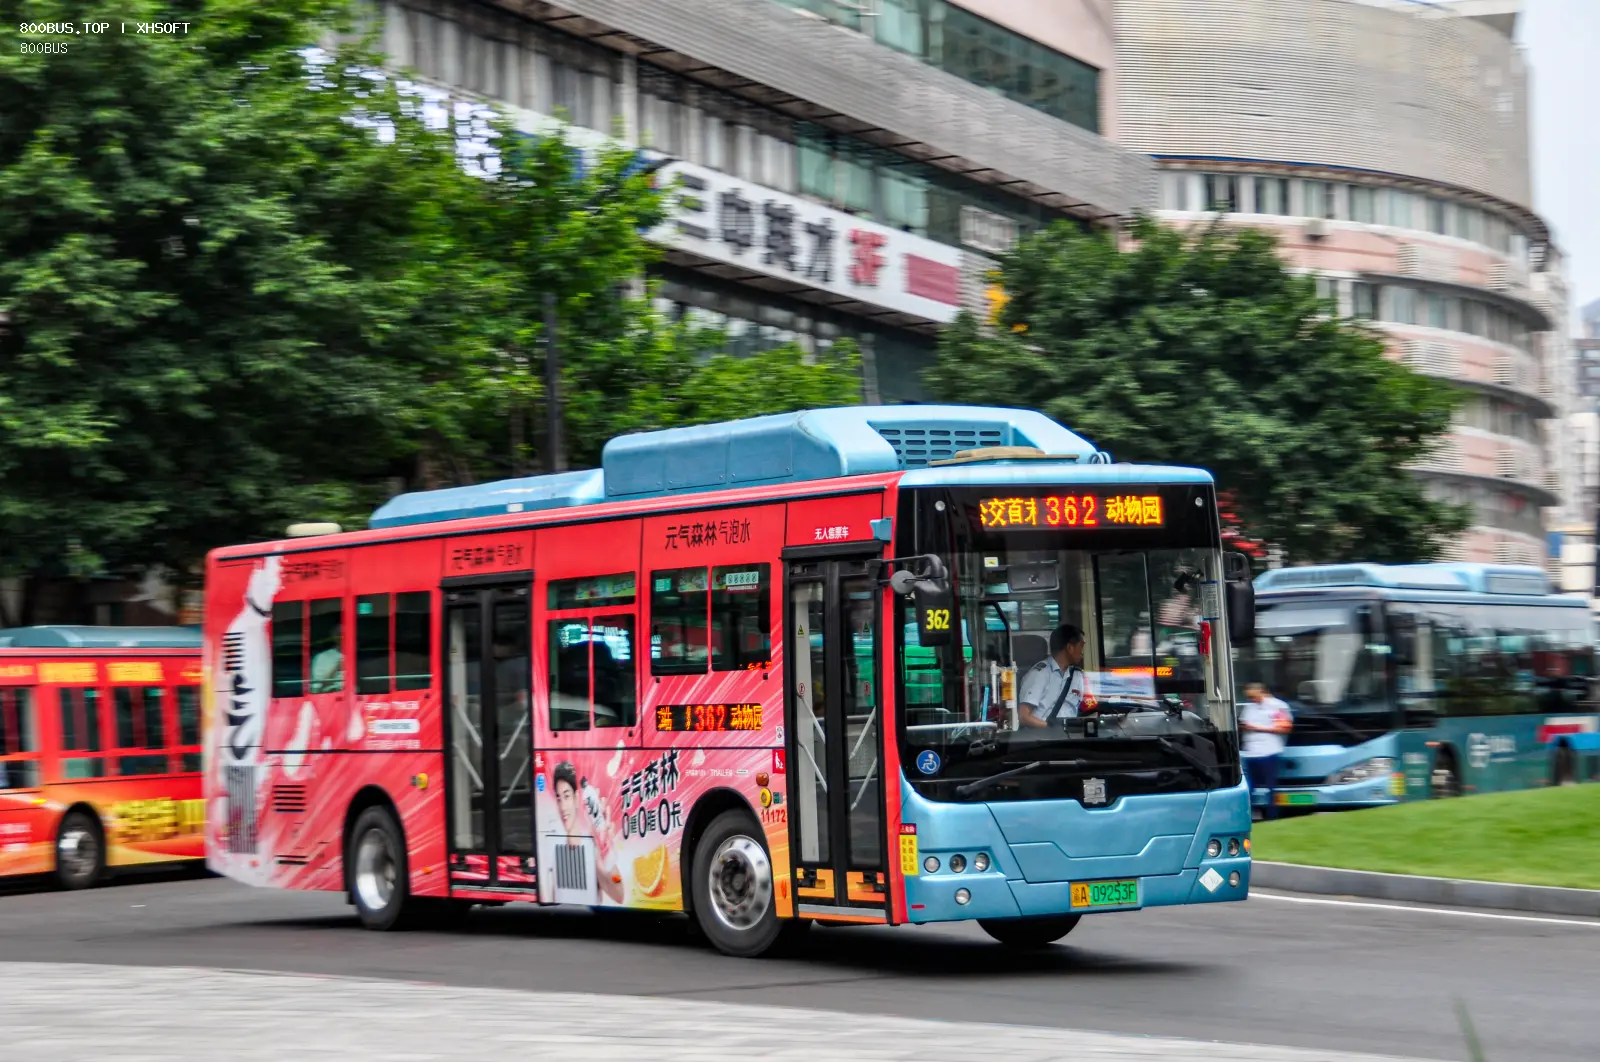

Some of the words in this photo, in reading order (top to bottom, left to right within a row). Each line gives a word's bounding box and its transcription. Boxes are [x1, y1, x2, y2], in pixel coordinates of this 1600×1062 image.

[1045, 495, 1097, 525] 362
[1106, 495, 1163, 525] 动物园
[814, 526, 849, 541] 无人售票车
[925, 608, 950, 630] 362
[694, 704, 727, 732] 362
[730, 704, 763, 731] 动物园
[621, 746, 679, 810] 元气森林
[761, 809, 786, 823] 11172
[1093, 883, 1135, 902] 09253F
